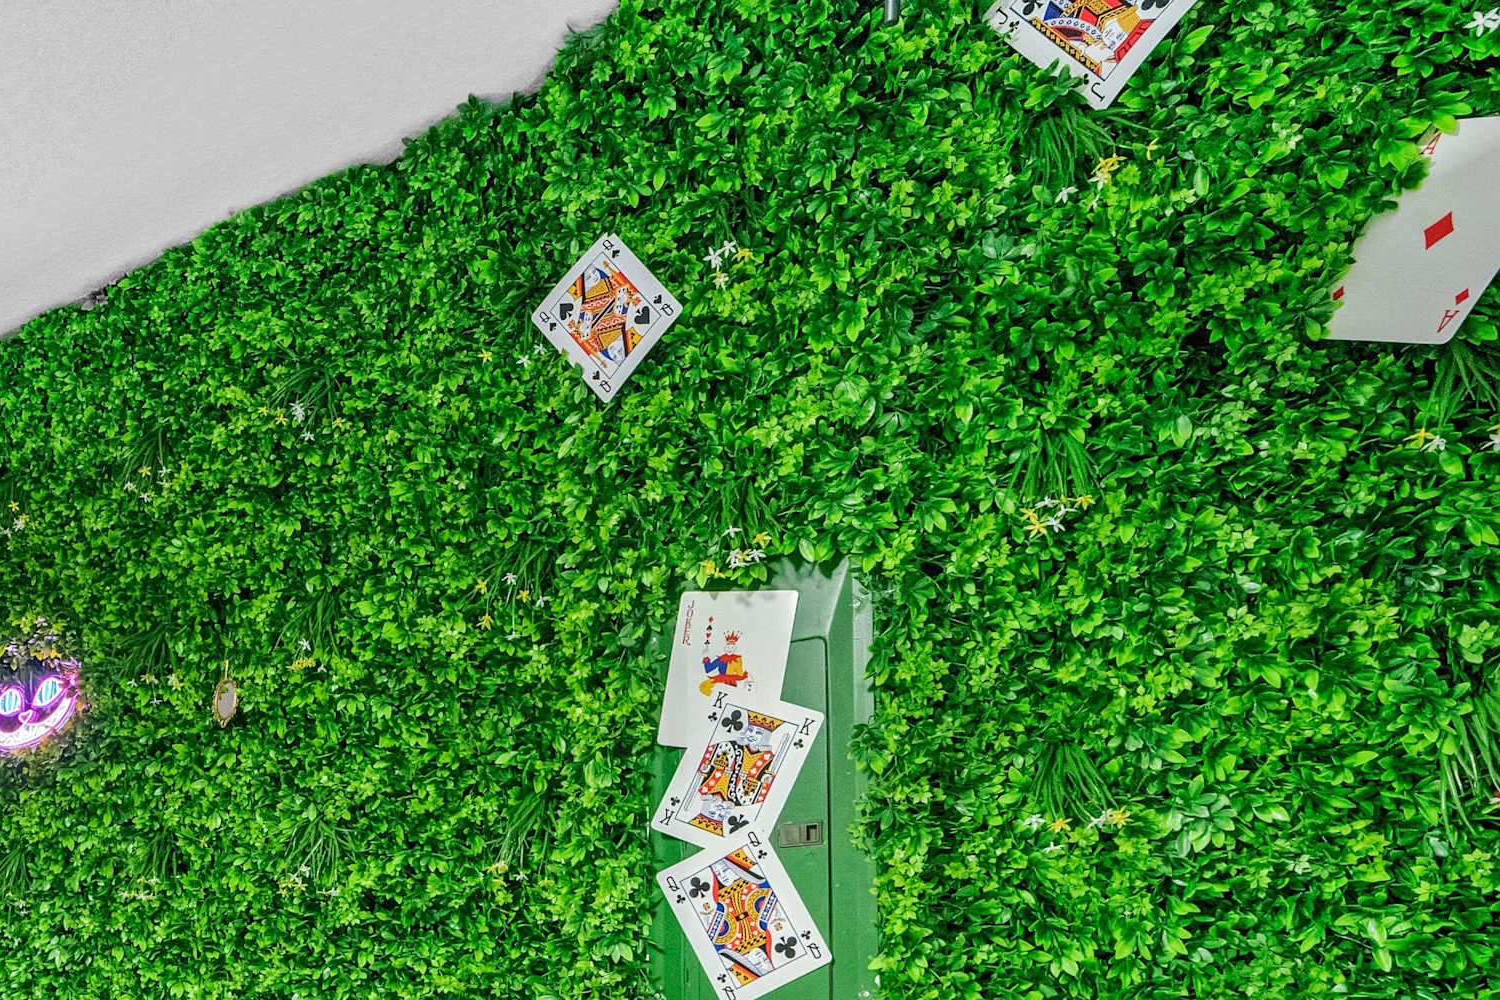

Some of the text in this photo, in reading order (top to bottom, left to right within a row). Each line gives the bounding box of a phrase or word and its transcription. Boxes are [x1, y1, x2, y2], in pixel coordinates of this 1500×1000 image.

[1437, 309, 1460, 333] A
[713, 691, 728, 709] K
[799, 717, 816, 736] K
[660, 808, 675, 826] K
[748, 831, 762, 847] Q
[666, 876, 680, 892] Q
[806, 943, 822, 959] Q
